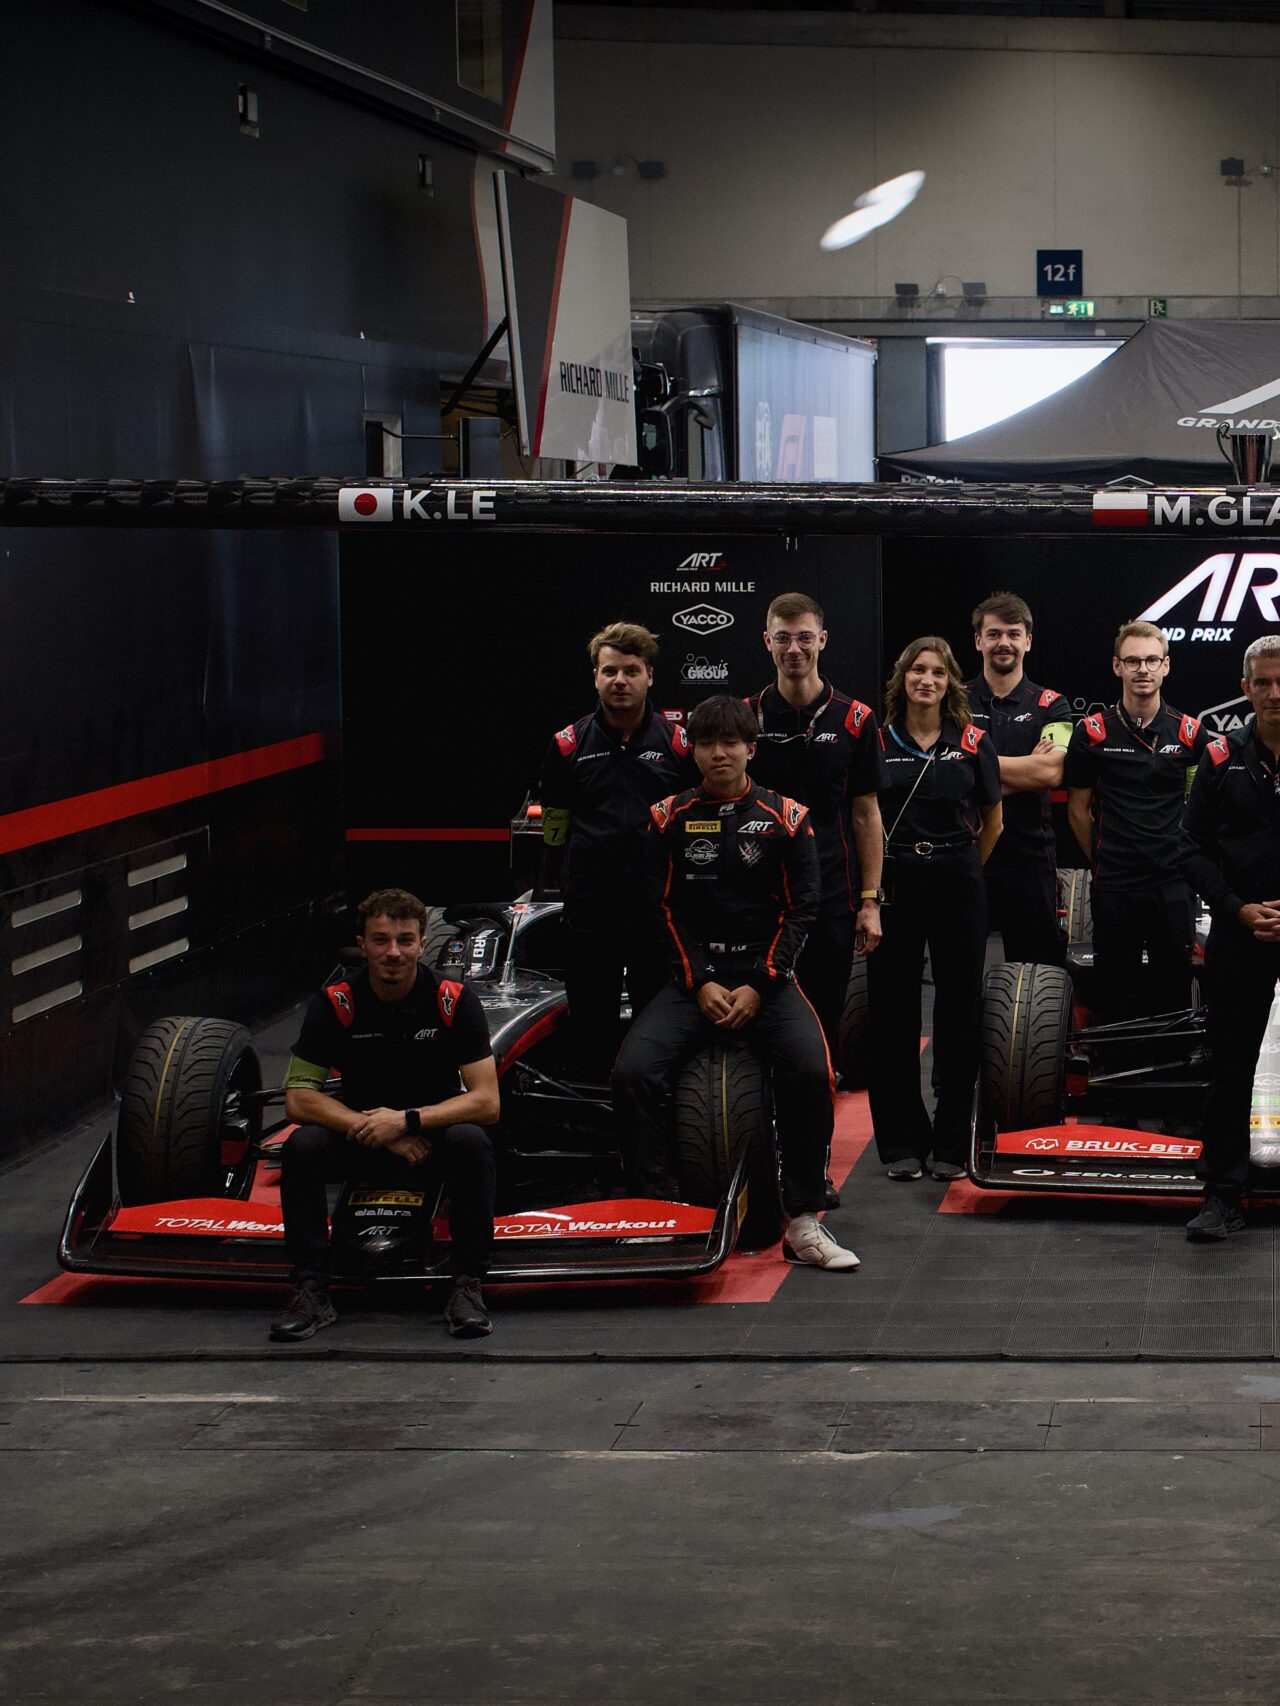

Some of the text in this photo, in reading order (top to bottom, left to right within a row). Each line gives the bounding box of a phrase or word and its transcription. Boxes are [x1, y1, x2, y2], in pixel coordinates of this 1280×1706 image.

[560, 361, 629, 403] RICHARD MILLE
[403, 489, 497, 521] K.LE
[679, 552, 723, 567] ART
[650, 582, 756, 593] RICHARD MILLE
[680, 614, 728, 625] YACCO
[1191, 628, 1234, 641] PRIX
[687, 669, 728, 680] GROUP
[814, 732, 837, 742] ART
[1159, 744, 1181, 754] ART
[638, 750, 664, 760] ART
[739, 820, 774, 830] ART
[413, 1029, 438, 1040] ART
[1065, 1140, 1201, 1154] BRUK-BET
[1061, 1171, 1197, 1180] ZEN.COM
[354, 1208, 412, 1217] dallara
[357, 1226, 400, 1236] ART
